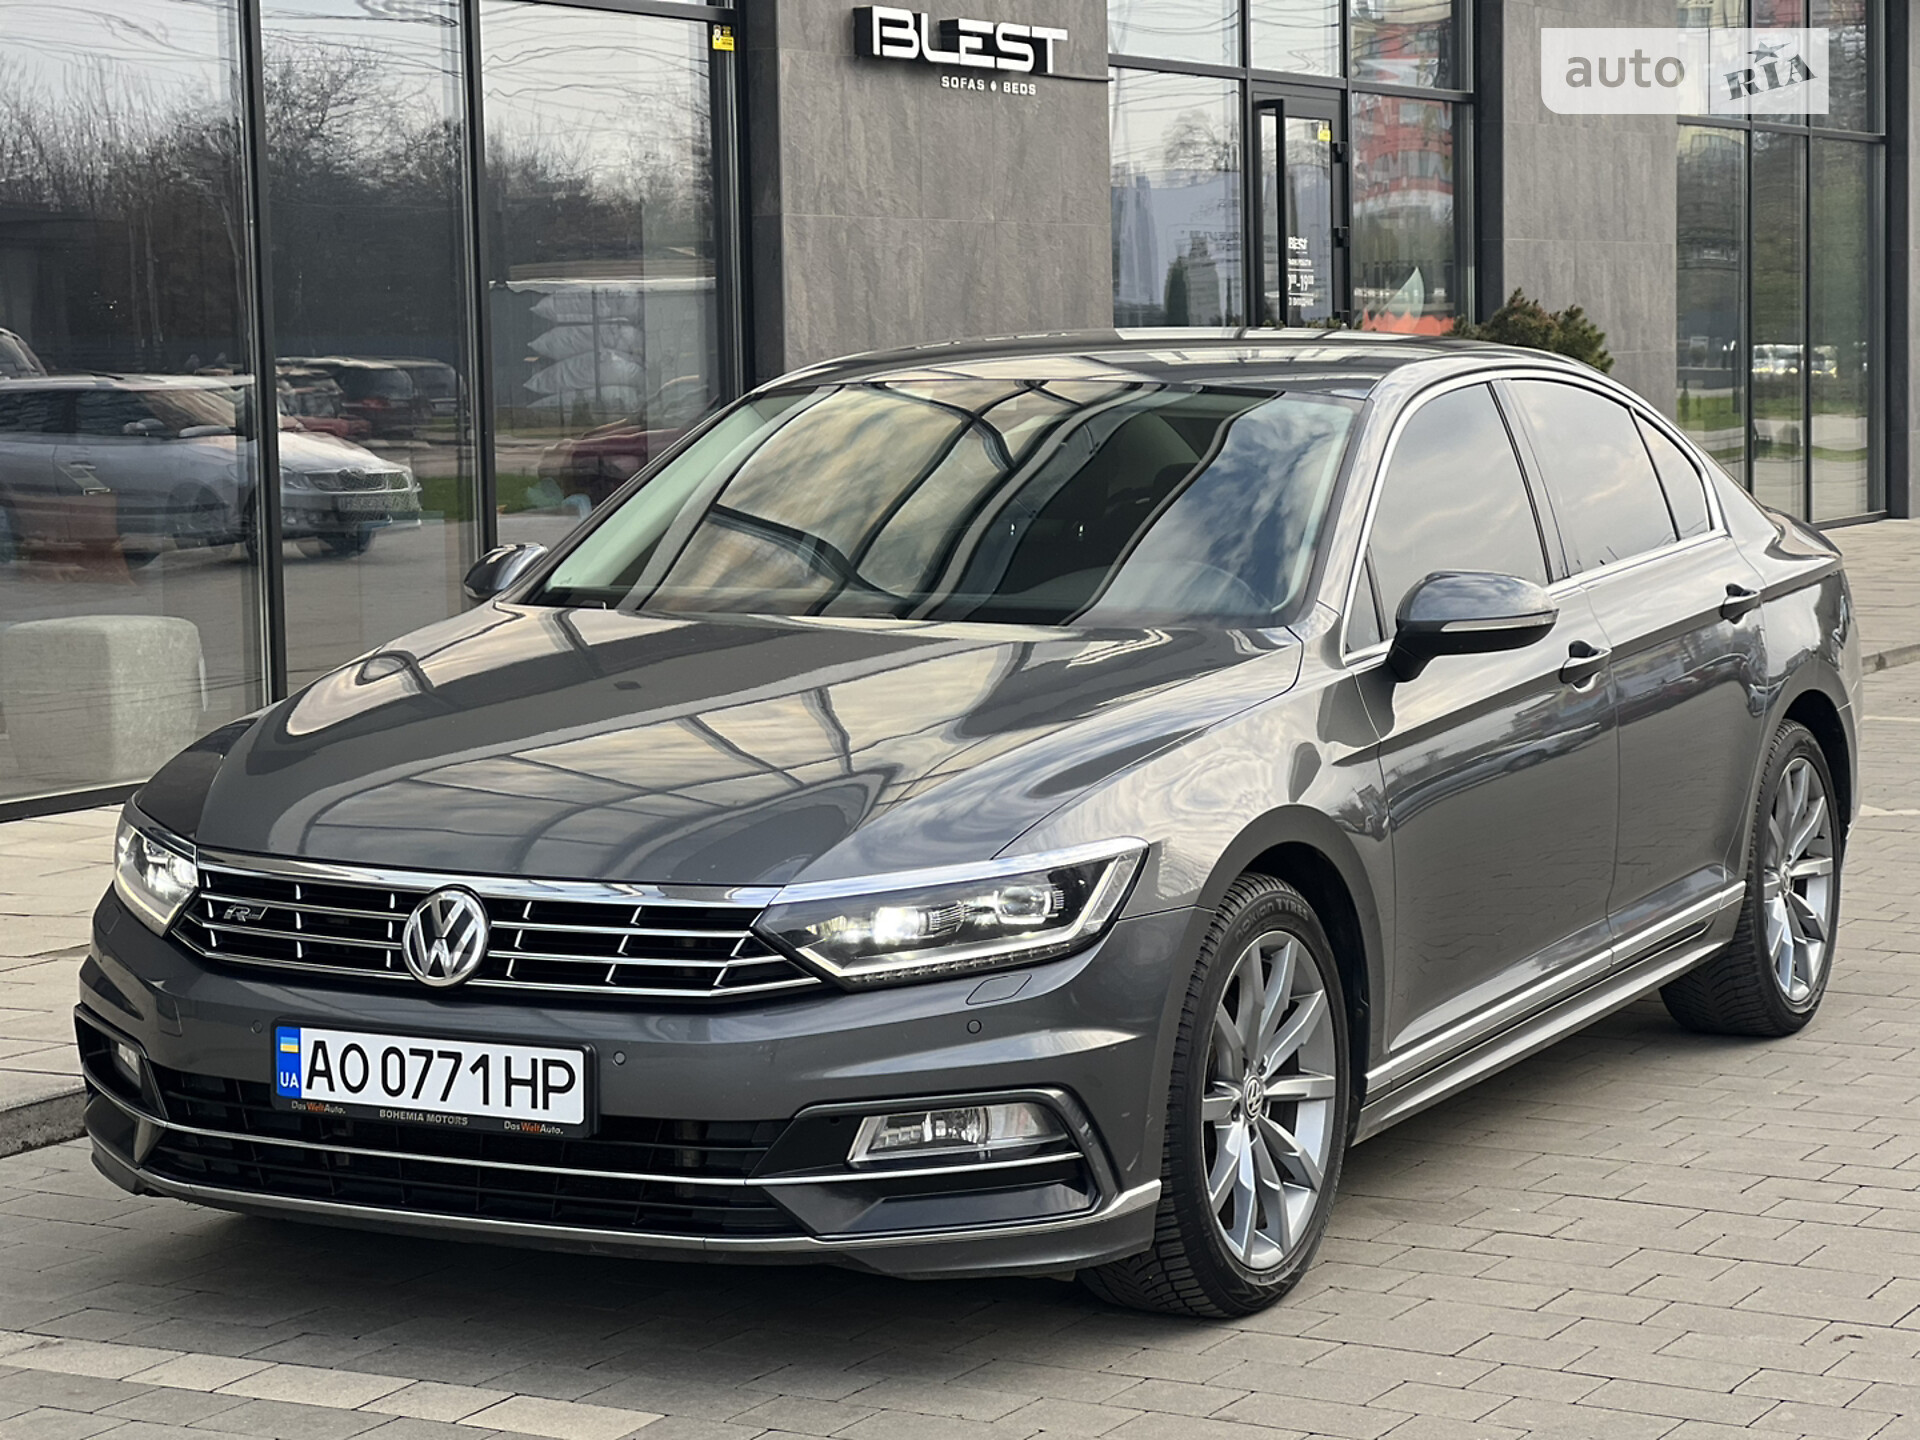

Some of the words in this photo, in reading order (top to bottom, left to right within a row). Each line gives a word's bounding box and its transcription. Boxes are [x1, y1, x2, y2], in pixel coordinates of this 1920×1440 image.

[872, 5, 1068, 74] BLEST
[941, 75, 985, 91] SOFAS
[1003, 81, 1037, 95] BEDS
[280, 1071, 299, 1088] UA
[305, 1040, 369, 1094] AO
[380, 1045, 490, 1106] 0771
[504, 1055, 576, 1110] HP
[379, 1109, 424, 1122] BOHEMIA
[426, 1113, 468, 1126] MOTORS
